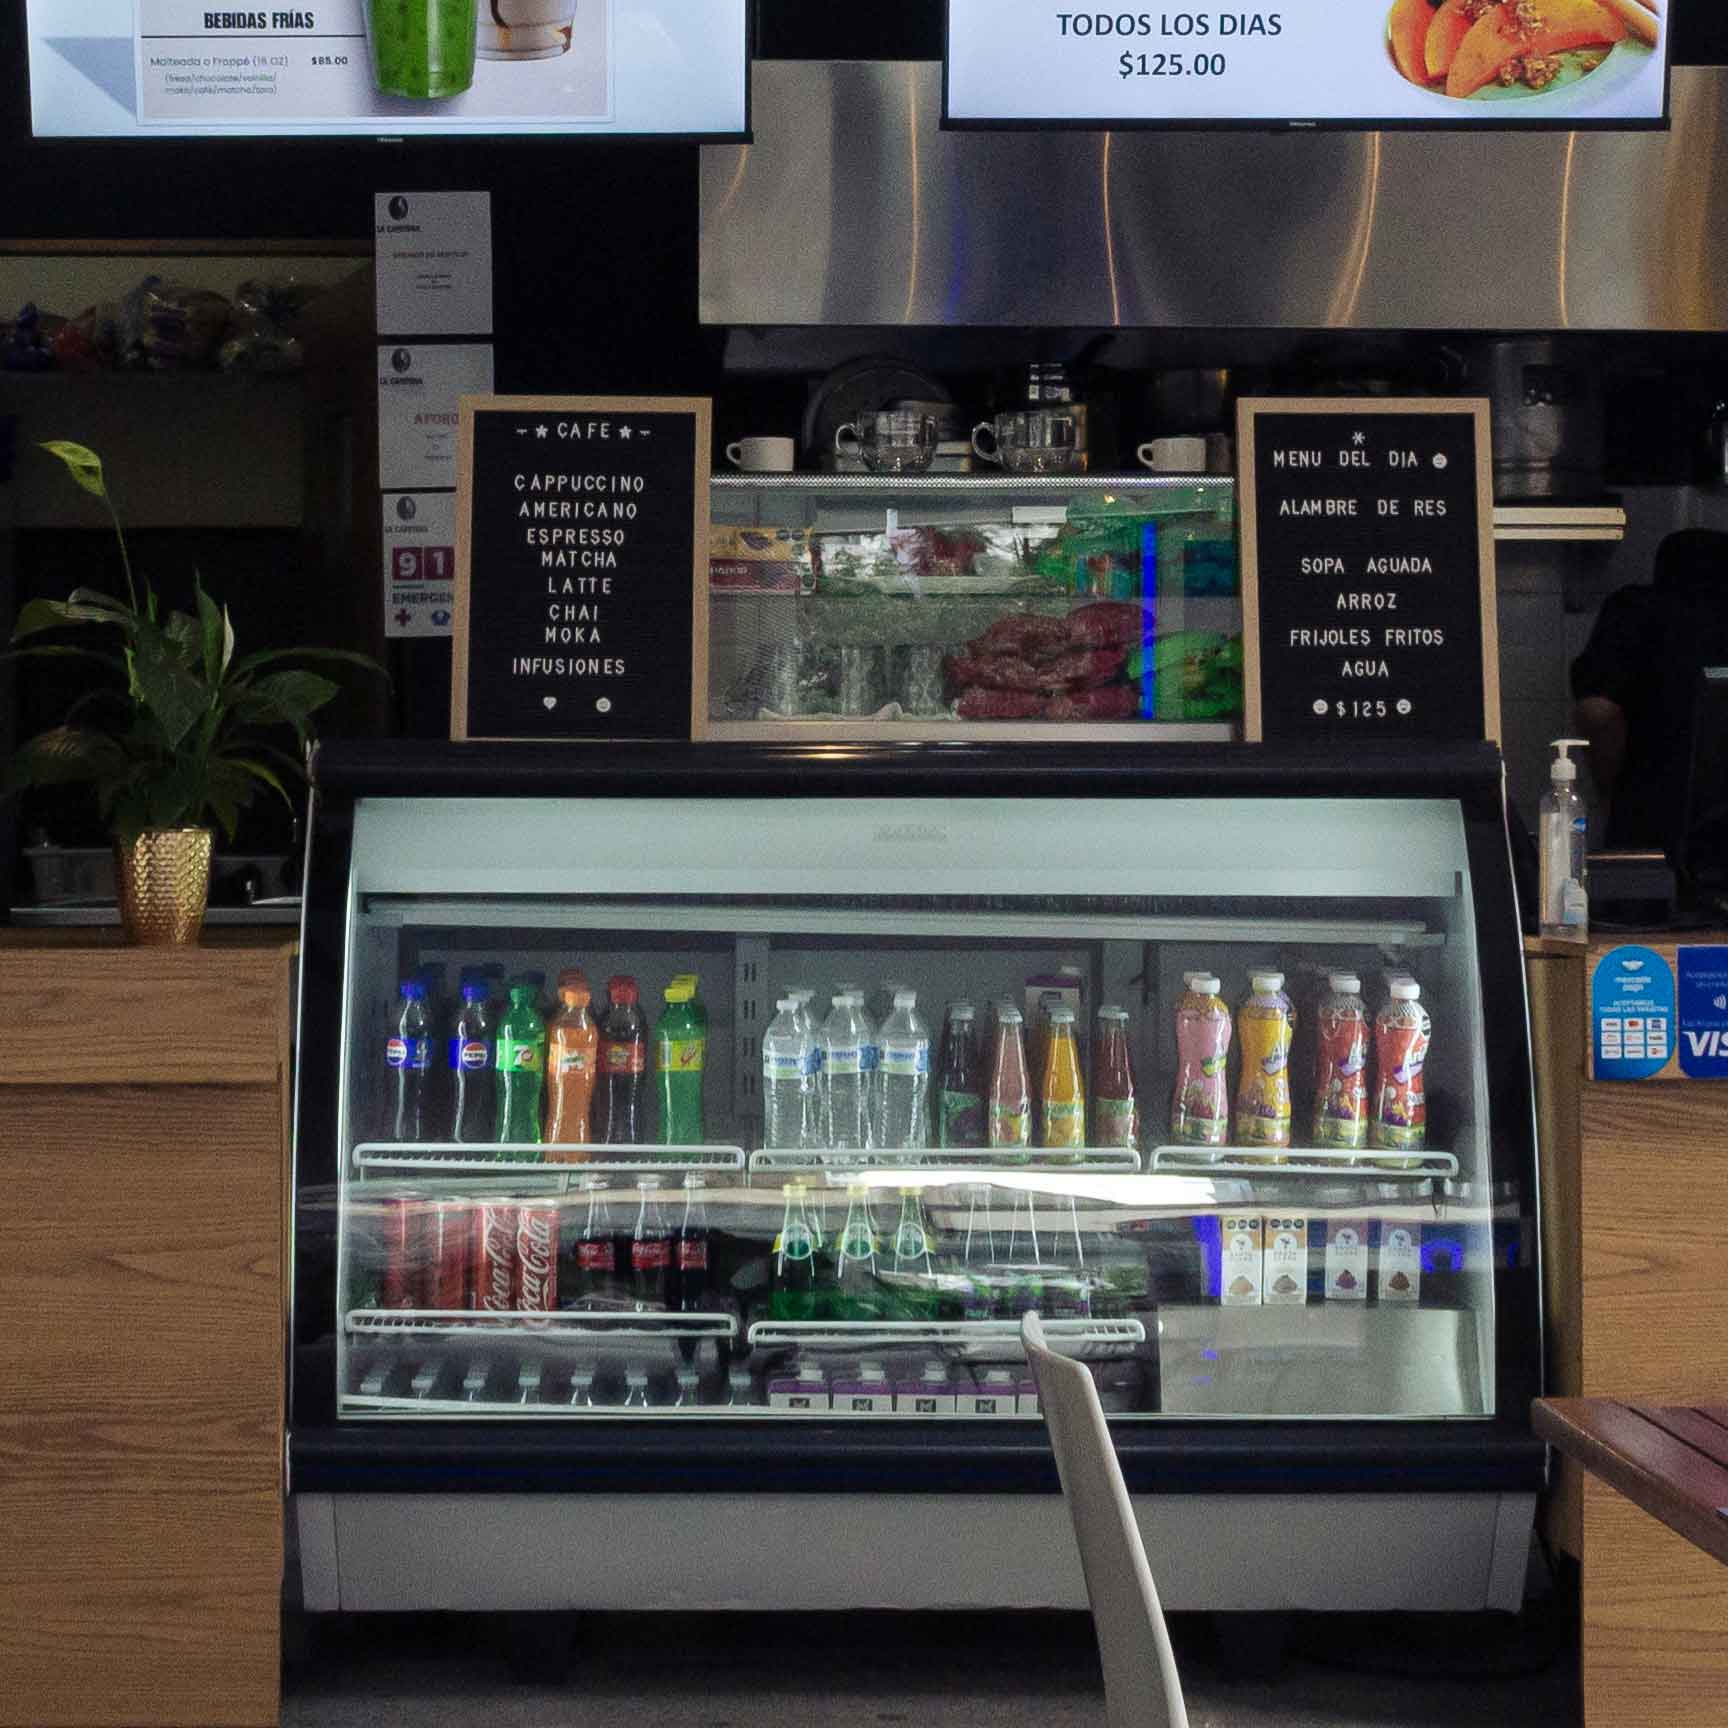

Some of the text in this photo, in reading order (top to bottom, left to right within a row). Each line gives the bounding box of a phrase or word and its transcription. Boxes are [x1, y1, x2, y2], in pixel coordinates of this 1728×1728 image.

[203, 8, 315, 31] BEBIDAS FRÍAS
[1056, 12, 1283, 37] TODOS LOS DIAS
[150, 55, 201, 68] Malteada
[1118, 52, 1227, 79] $125.00
[556, 422, 612, 440] CAFE
[1273, 450, 1419, 468] MENU DEL DIA
[514, 474, 645, 493] CAPPUCCINO
[518, 501, 638, 520] AMERICANO
[1279, 499, 1447, 516] ALAMBRE DE RES
[526, 527, 626, 546] ESPRESSO
[541, 551, 618, 569] MATCHA
[1301, 557, 1433, 574] SOPA AGUADA
[547, 576, 613, 595] LATTE
[1335, 593, 1398, 610] ARROZ
[548, 603, 600, 622] CHAI
[544, 626, 602, 645] MOKA
[1289, 629, 1445, 646] FRIJOLES FRITOS
[511, 657, 626, 675] INFUSIONES
[1341, 660, 1390, 678] AGUA
[1335, 701, 1388, 718] $125
